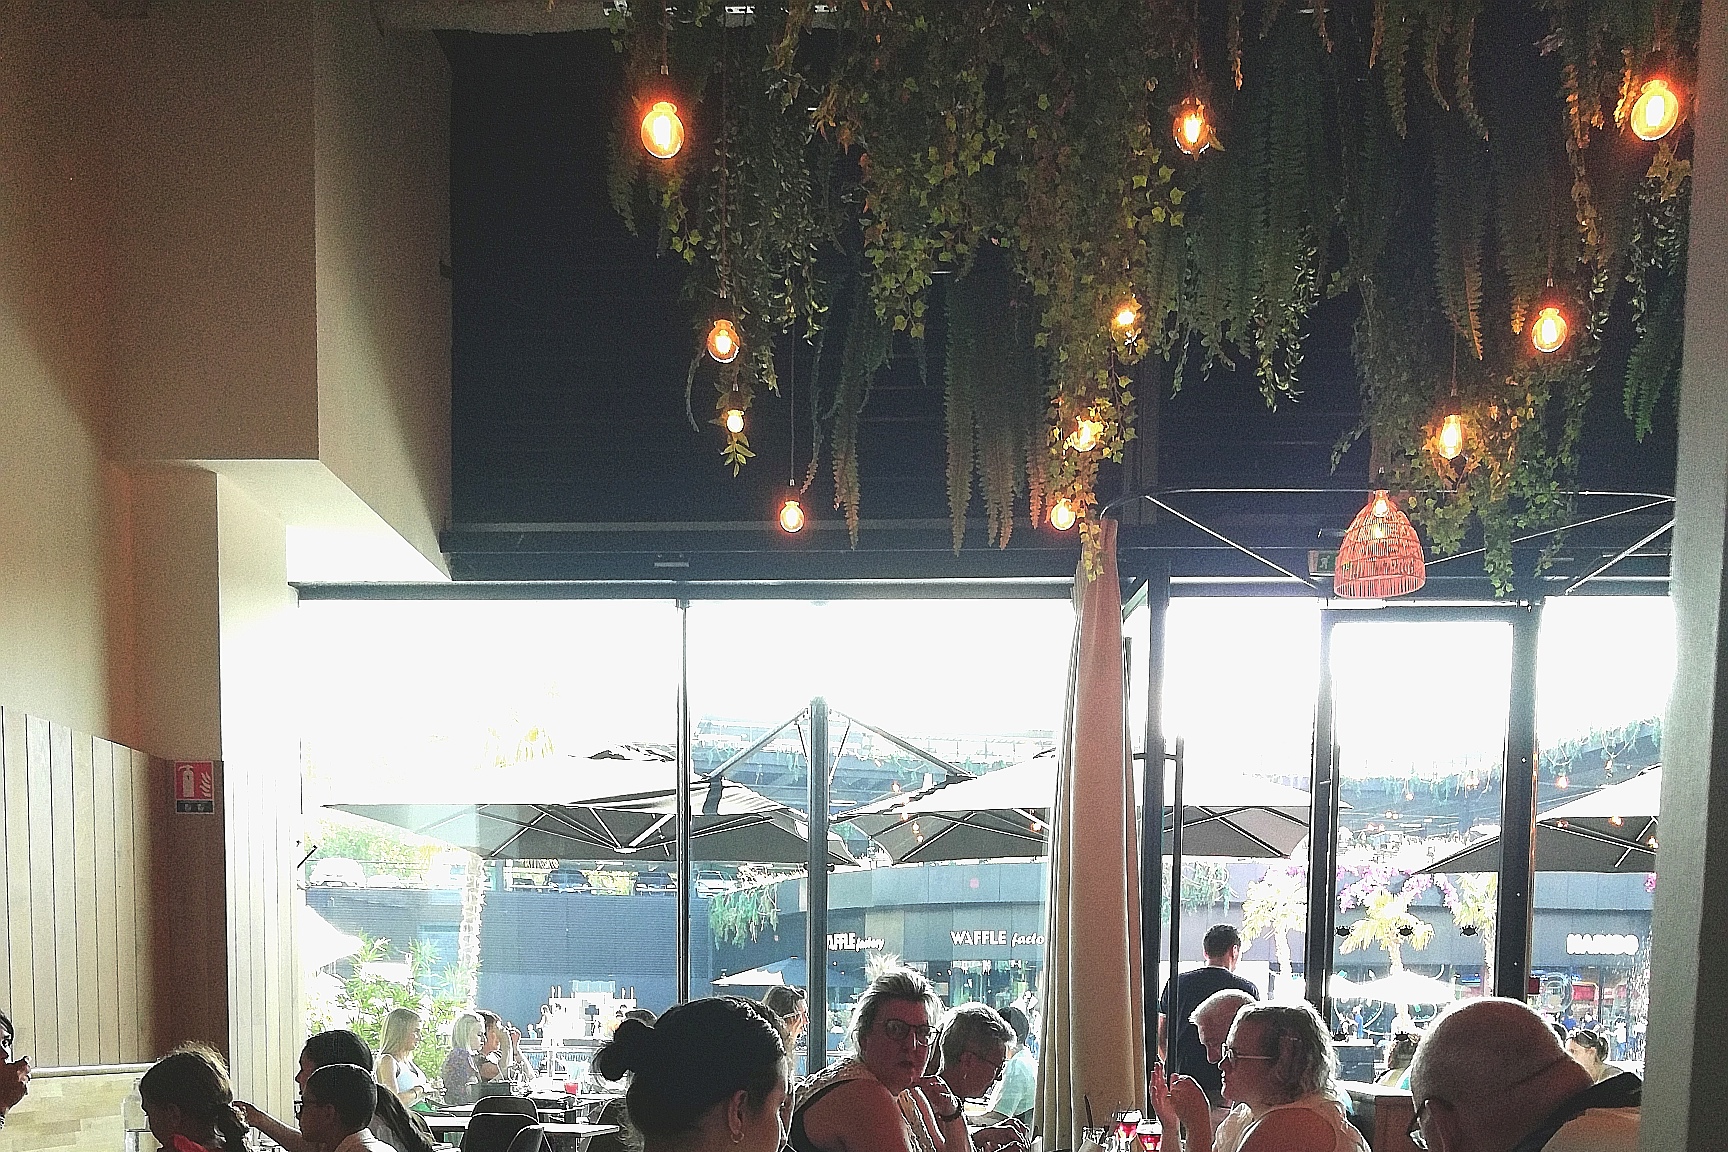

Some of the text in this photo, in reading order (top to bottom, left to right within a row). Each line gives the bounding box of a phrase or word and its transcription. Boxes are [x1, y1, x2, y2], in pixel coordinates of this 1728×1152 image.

[826, 932, 856, 951] AFFLE
[950, 930, 1045, 948] WAFFLE facto
